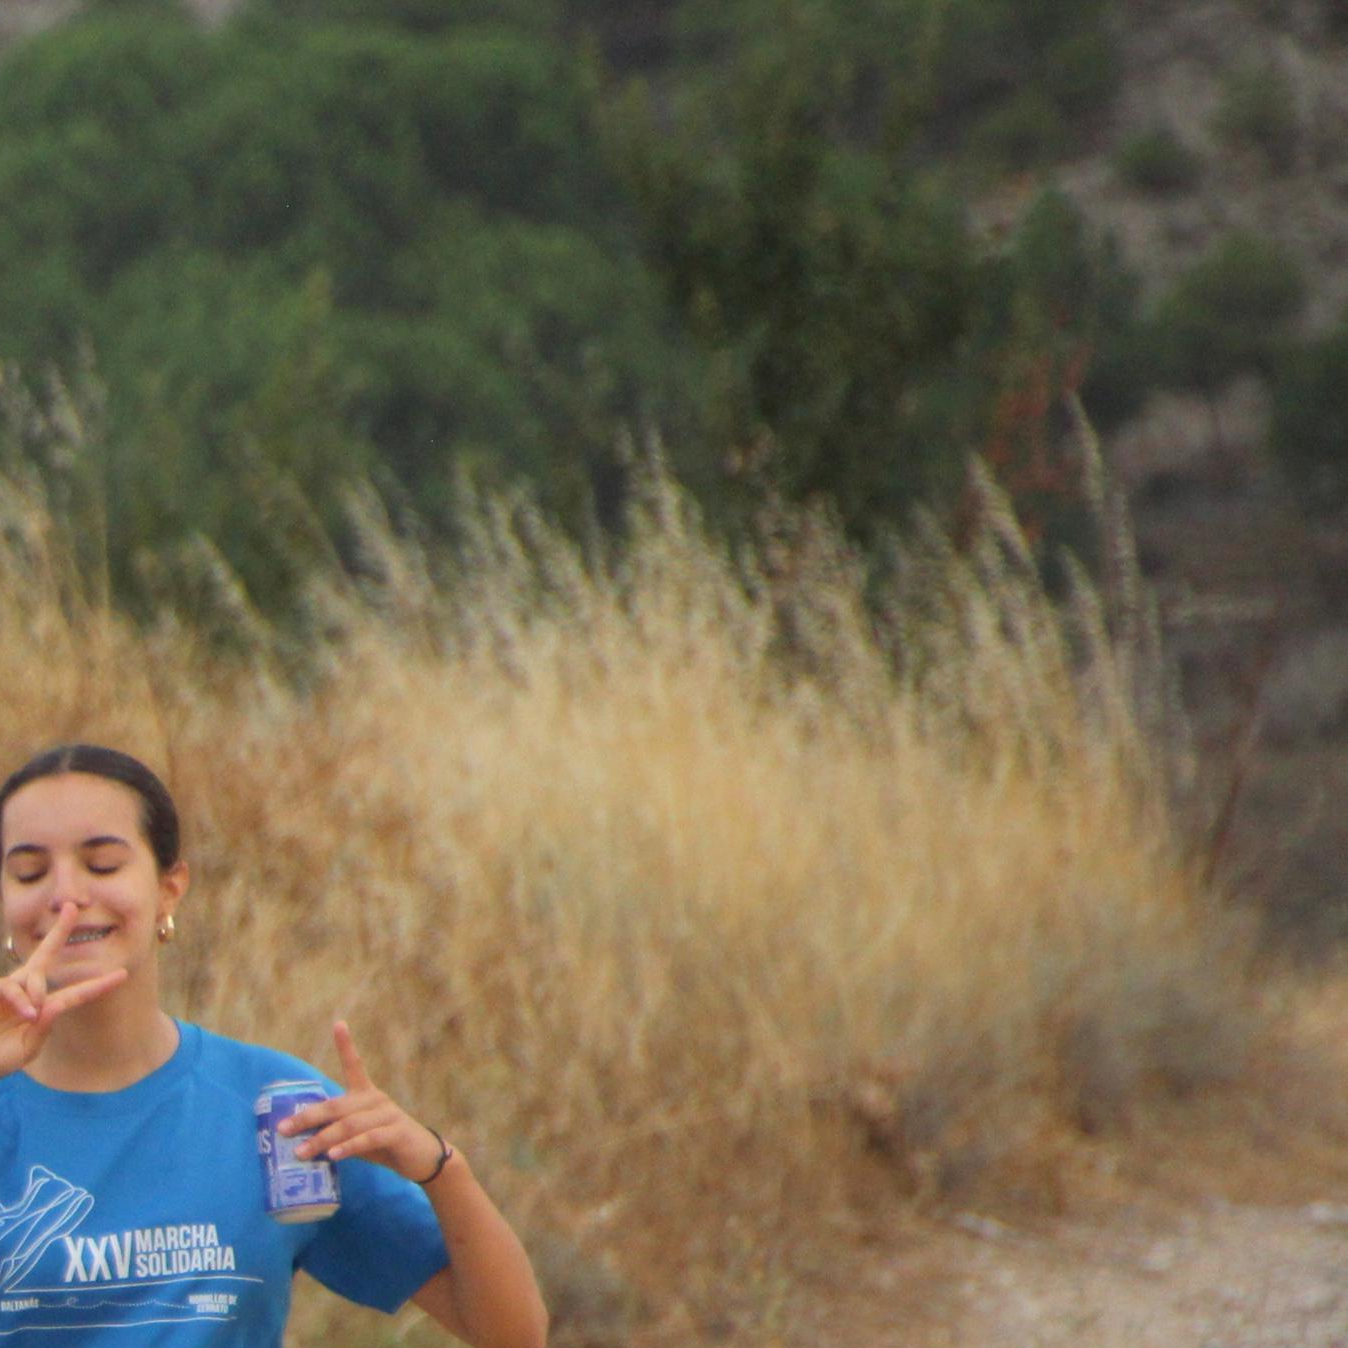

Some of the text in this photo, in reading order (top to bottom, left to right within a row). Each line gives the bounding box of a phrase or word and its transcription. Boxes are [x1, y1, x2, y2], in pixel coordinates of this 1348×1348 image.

[64, 1224, 219, 1283] XXV MARCHA
[134, 1246, 236, 1279] SOLIDARIA
